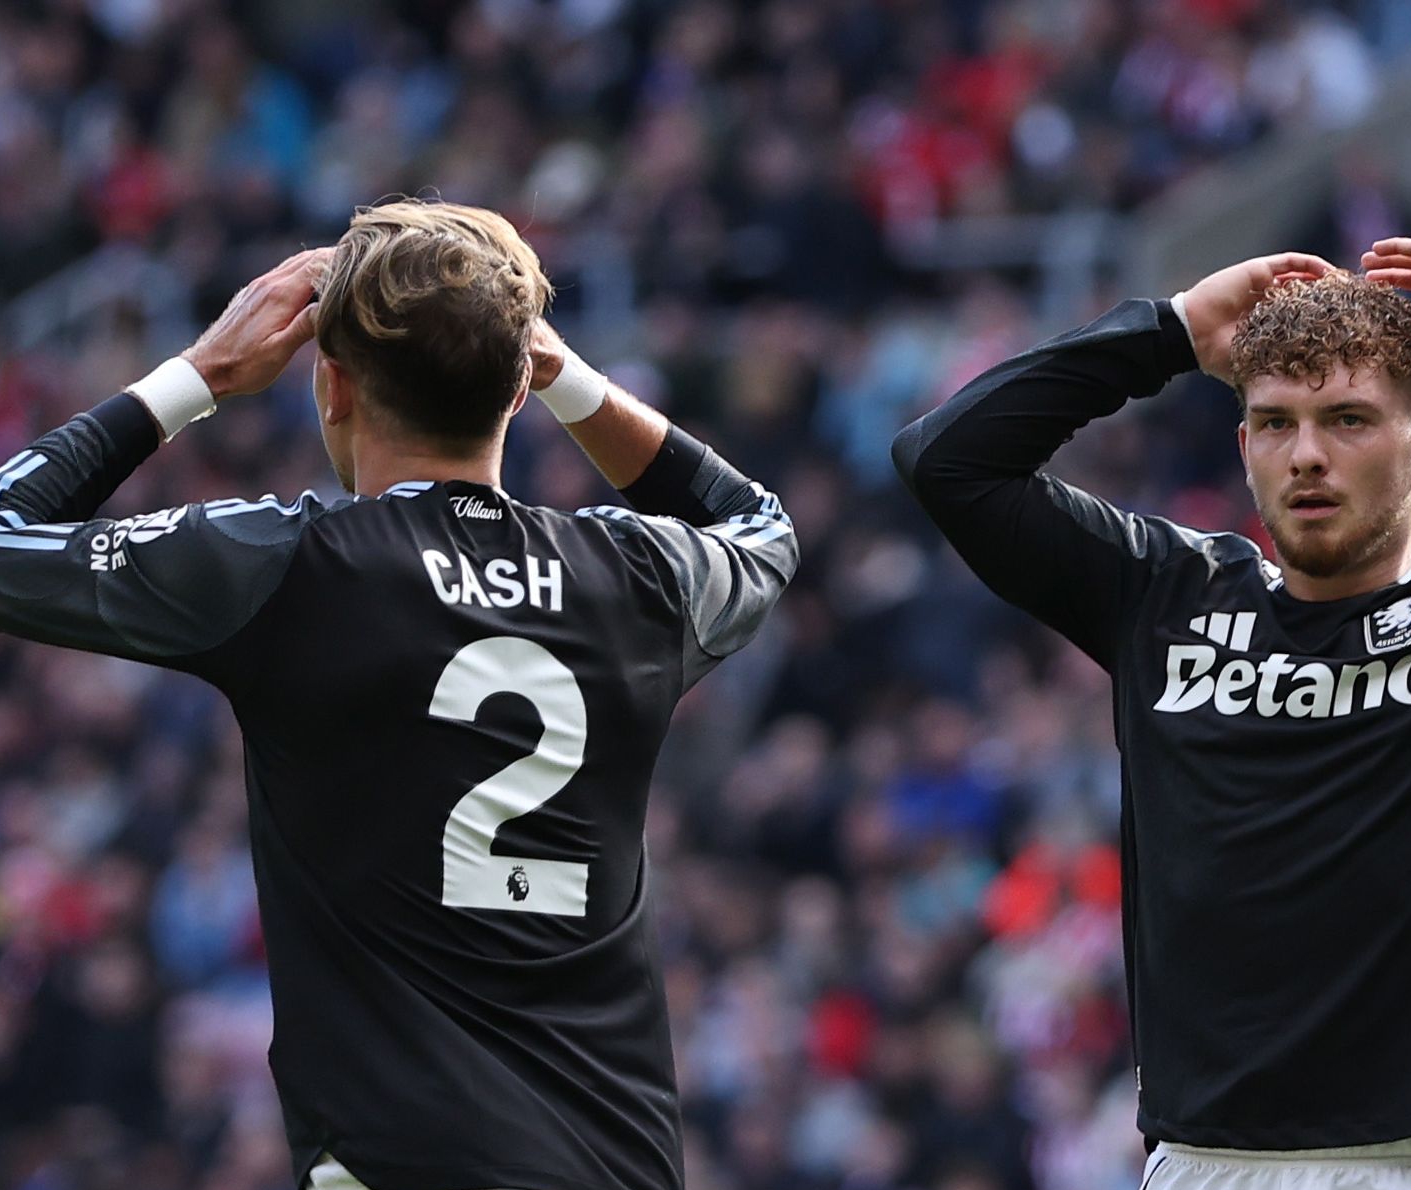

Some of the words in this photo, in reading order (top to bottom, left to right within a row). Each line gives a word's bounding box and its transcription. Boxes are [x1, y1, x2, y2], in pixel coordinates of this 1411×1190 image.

[449, 496, 503, 520] Villans
[422, 549, 563, 612] CASH
[428, 636, 588, 917] 2
